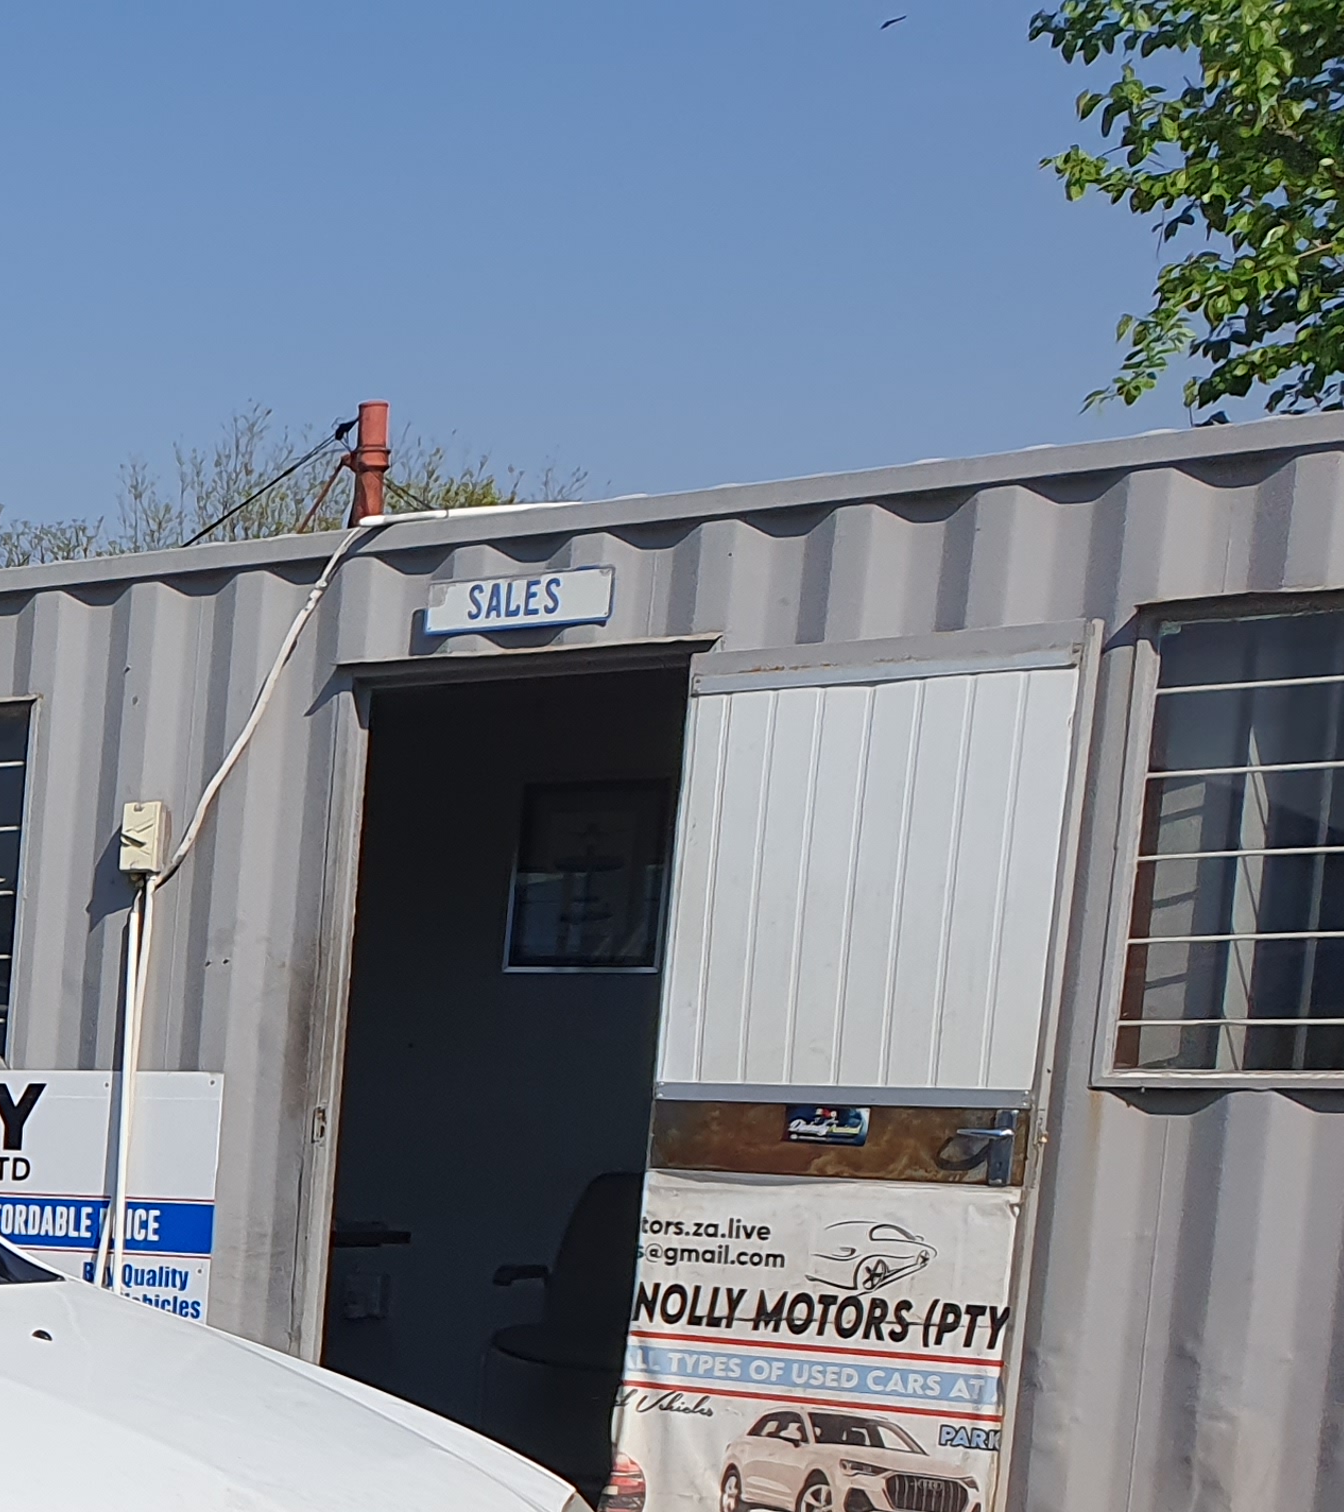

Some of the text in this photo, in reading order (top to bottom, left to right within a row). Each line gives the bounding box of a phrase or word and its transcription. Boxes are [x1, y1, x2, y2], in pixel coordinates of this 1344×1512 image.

[467, 577, 561, 620] SALES
[123, 1263, 189, 1292] Quality
[122, 1293, 201, 1320] hicles
[632, 1281, 748, 1330] NOLLY
[751, 1289, 915, 1343] MOTORS
[667, 1351, 742, 1378] TYPES
[749, 1359, 786, 1382] OF
[791, 1364, 859, 1390] USED
[867, 1369, 942, 1396] CARS
[948, 1376, 986, 1400] AT
